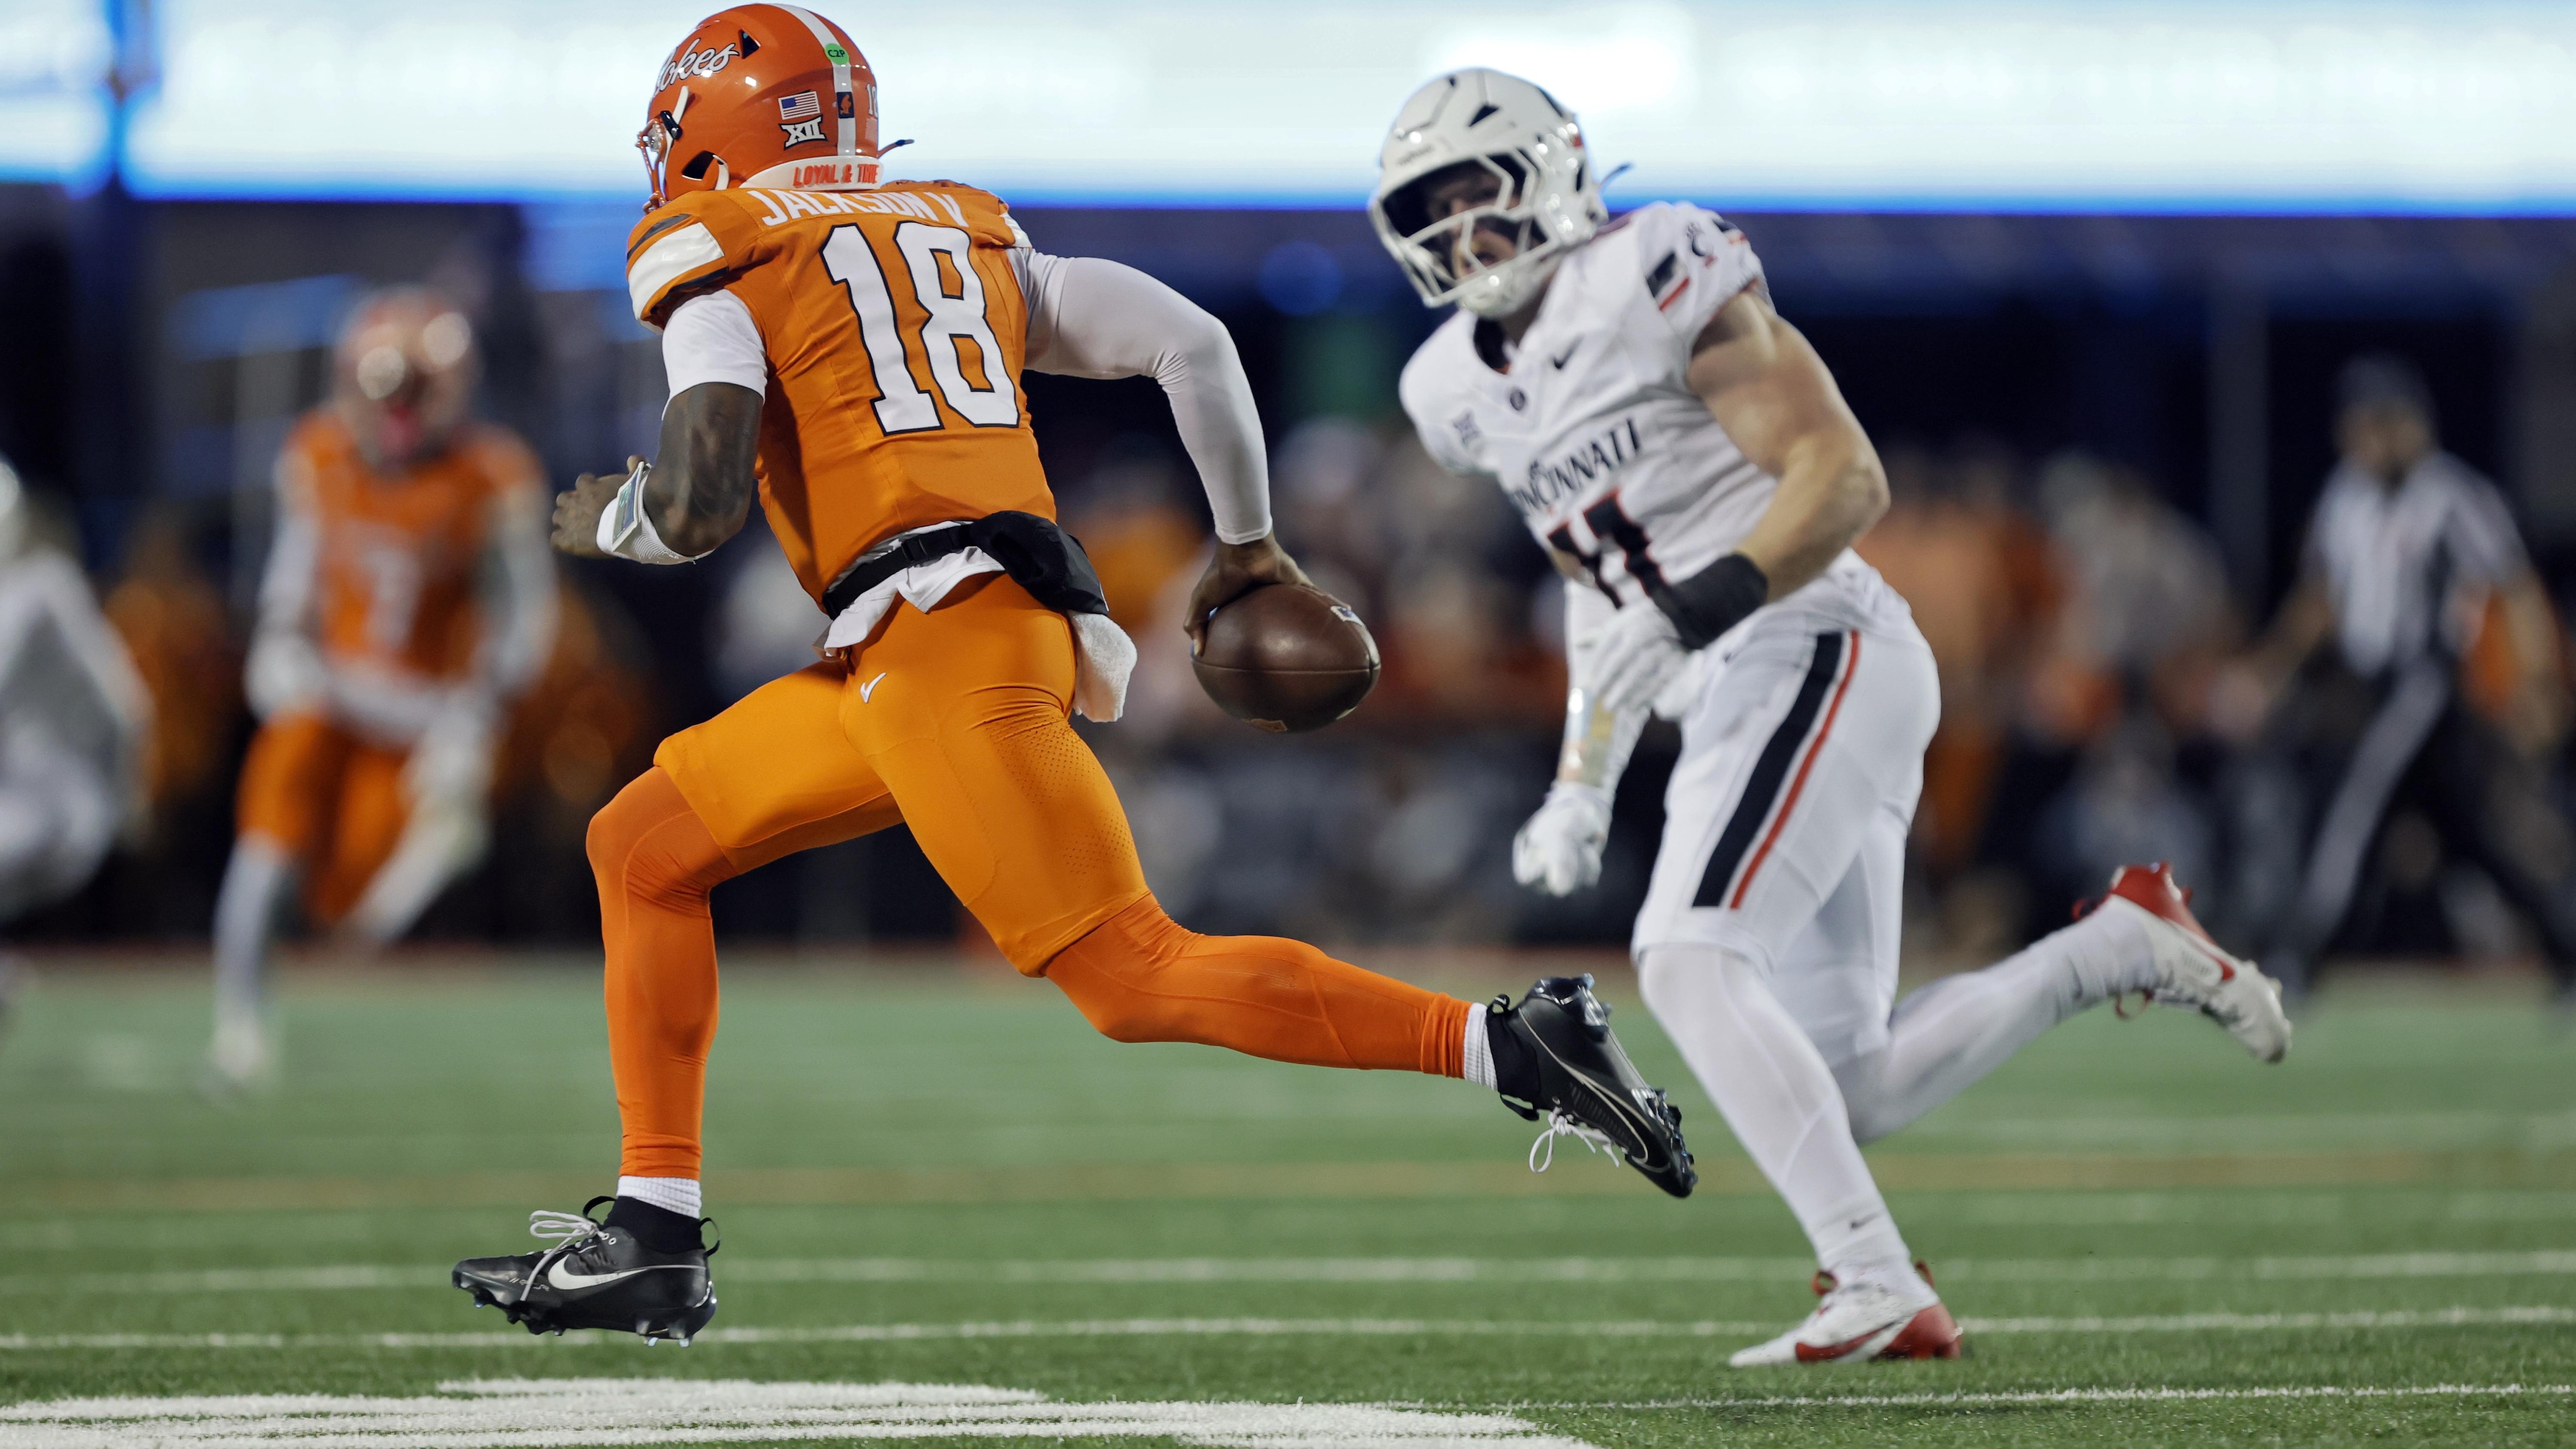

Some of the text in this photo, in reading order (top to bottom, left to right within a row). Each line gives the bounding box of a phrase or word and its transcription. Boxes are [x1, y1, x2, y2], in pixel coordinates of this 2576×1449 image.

[654, 38, 740, 96] okes
[827, 49, 845, 58] C2P
[779, 115, 828, 150] XII
[793, 164, 839, 187] LOYAL
[842, 164, 853, 183] &
[747, 189, 969, 227] JACKSON V
[819, 221, 1020, 436] 18
